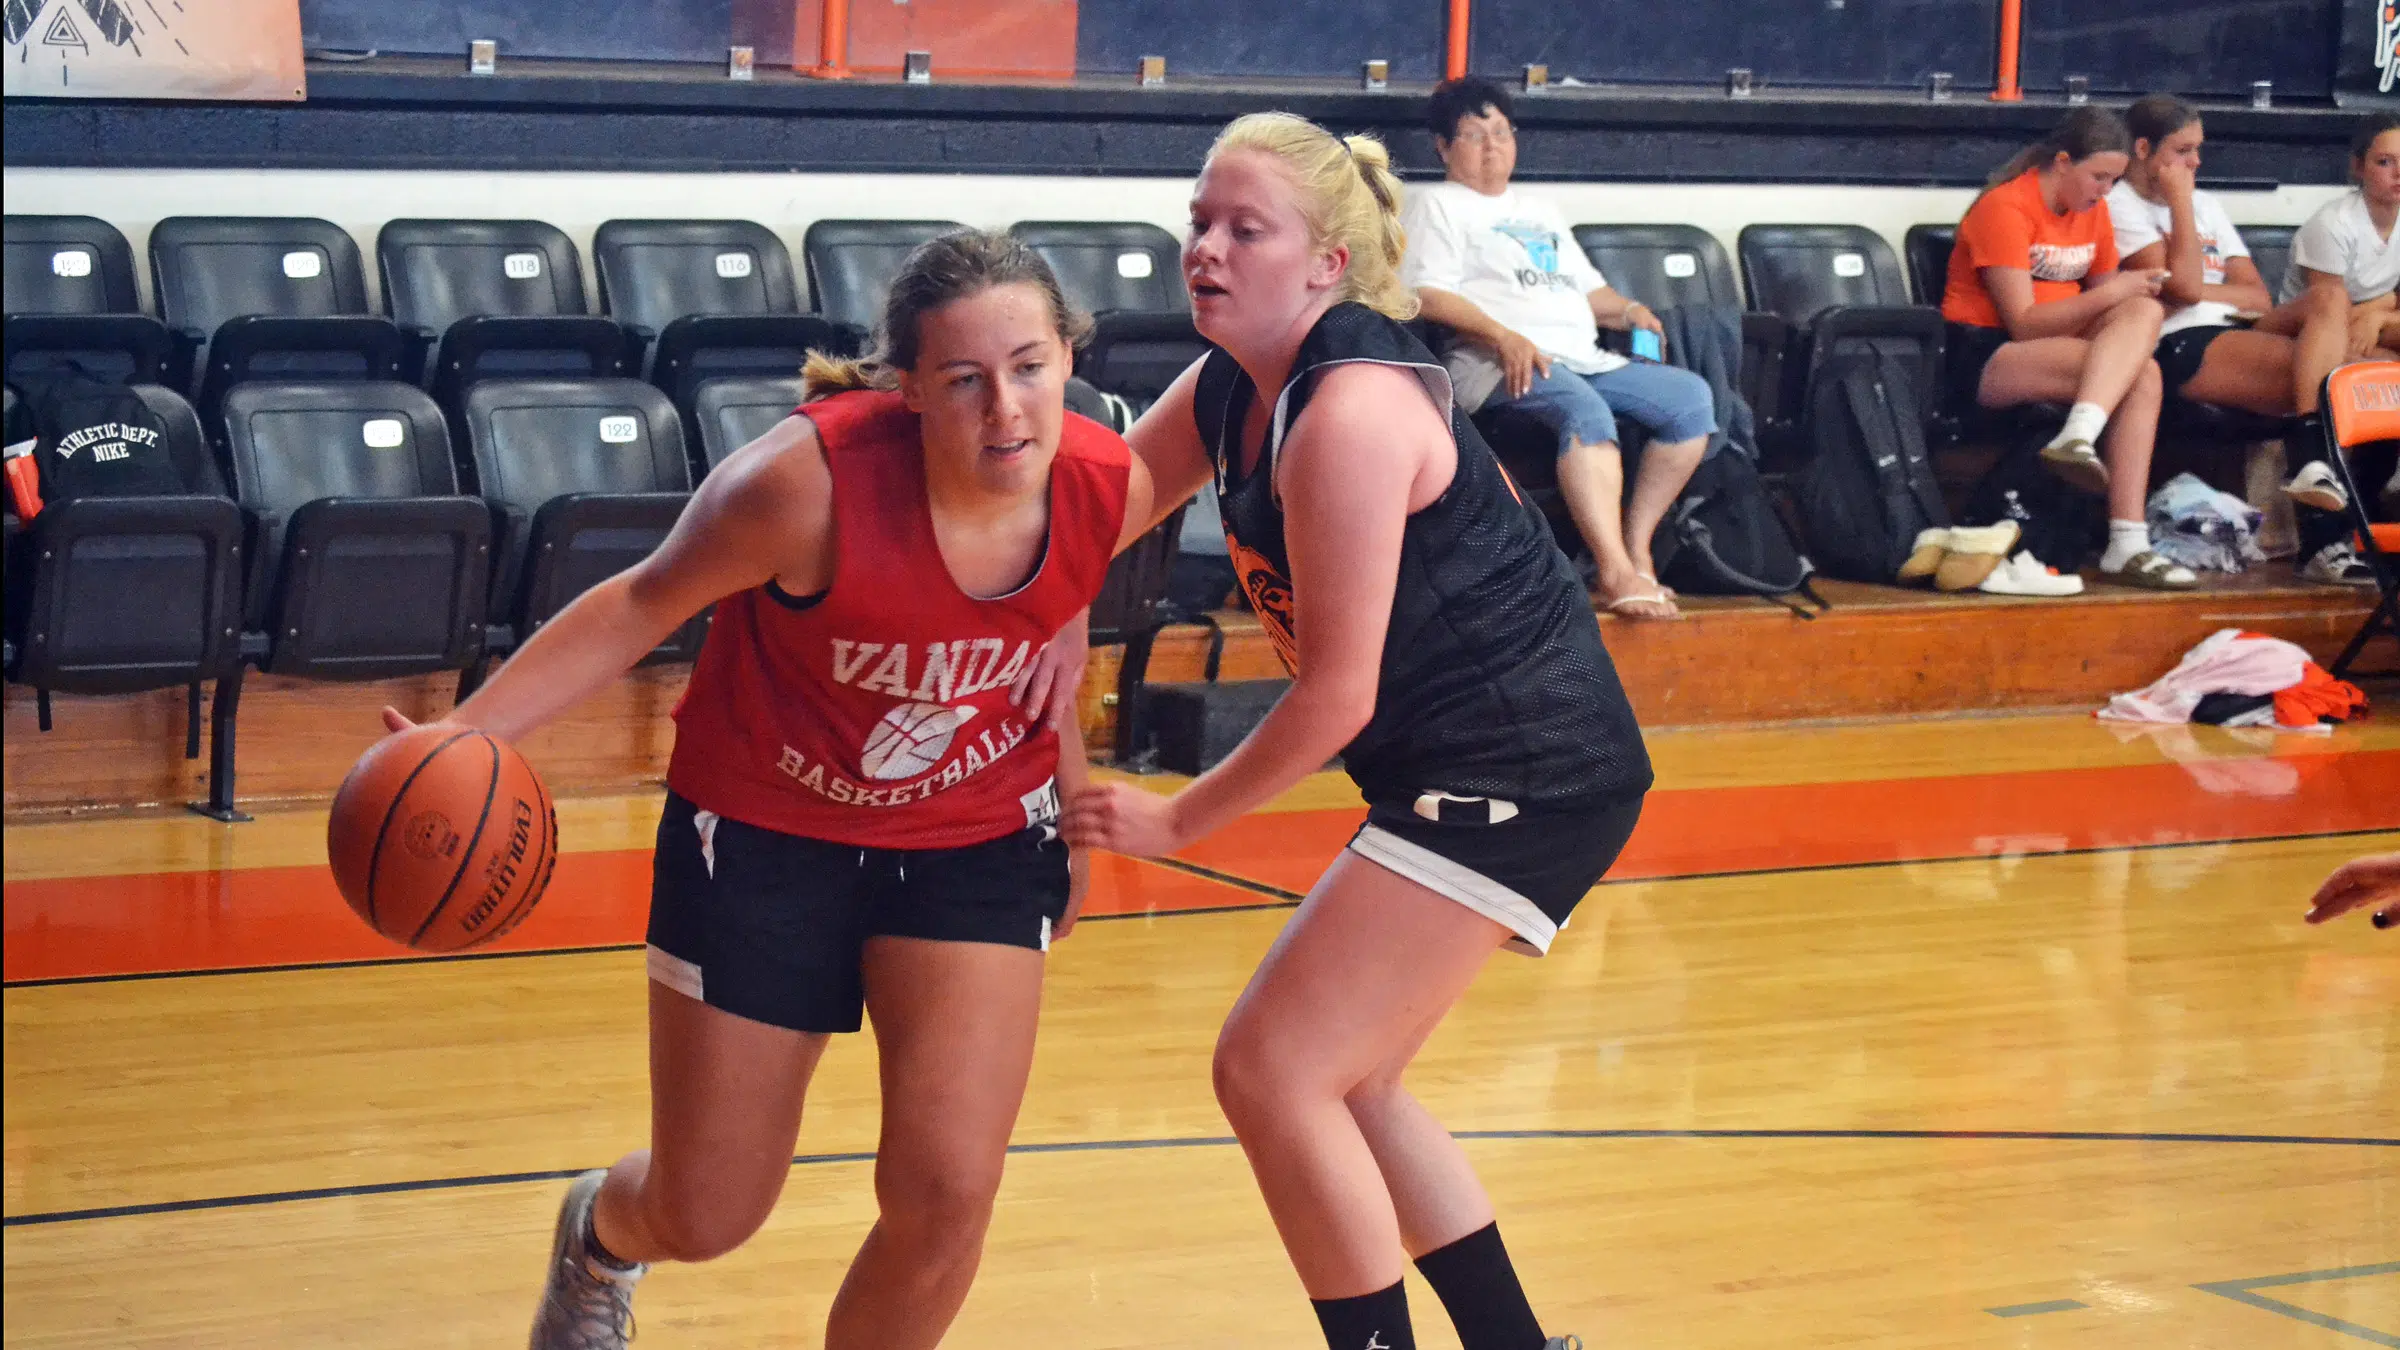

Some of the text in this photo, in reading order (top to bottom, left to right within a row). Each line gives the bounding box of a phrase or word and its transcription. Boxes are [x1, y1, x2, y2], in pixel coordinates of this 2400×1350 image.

[511, 260, 536, 273] 118
[722, 259, 746, 273] 116
[56, 422, 159, 459] ATHLETIC DEPT.
[606, 423, 633, 437] 122
[92, 441, 130, 463] NIKE
[830, 636, 1050, 702] VANDA
[776, 716, 1025, 807] BASKETBALL
